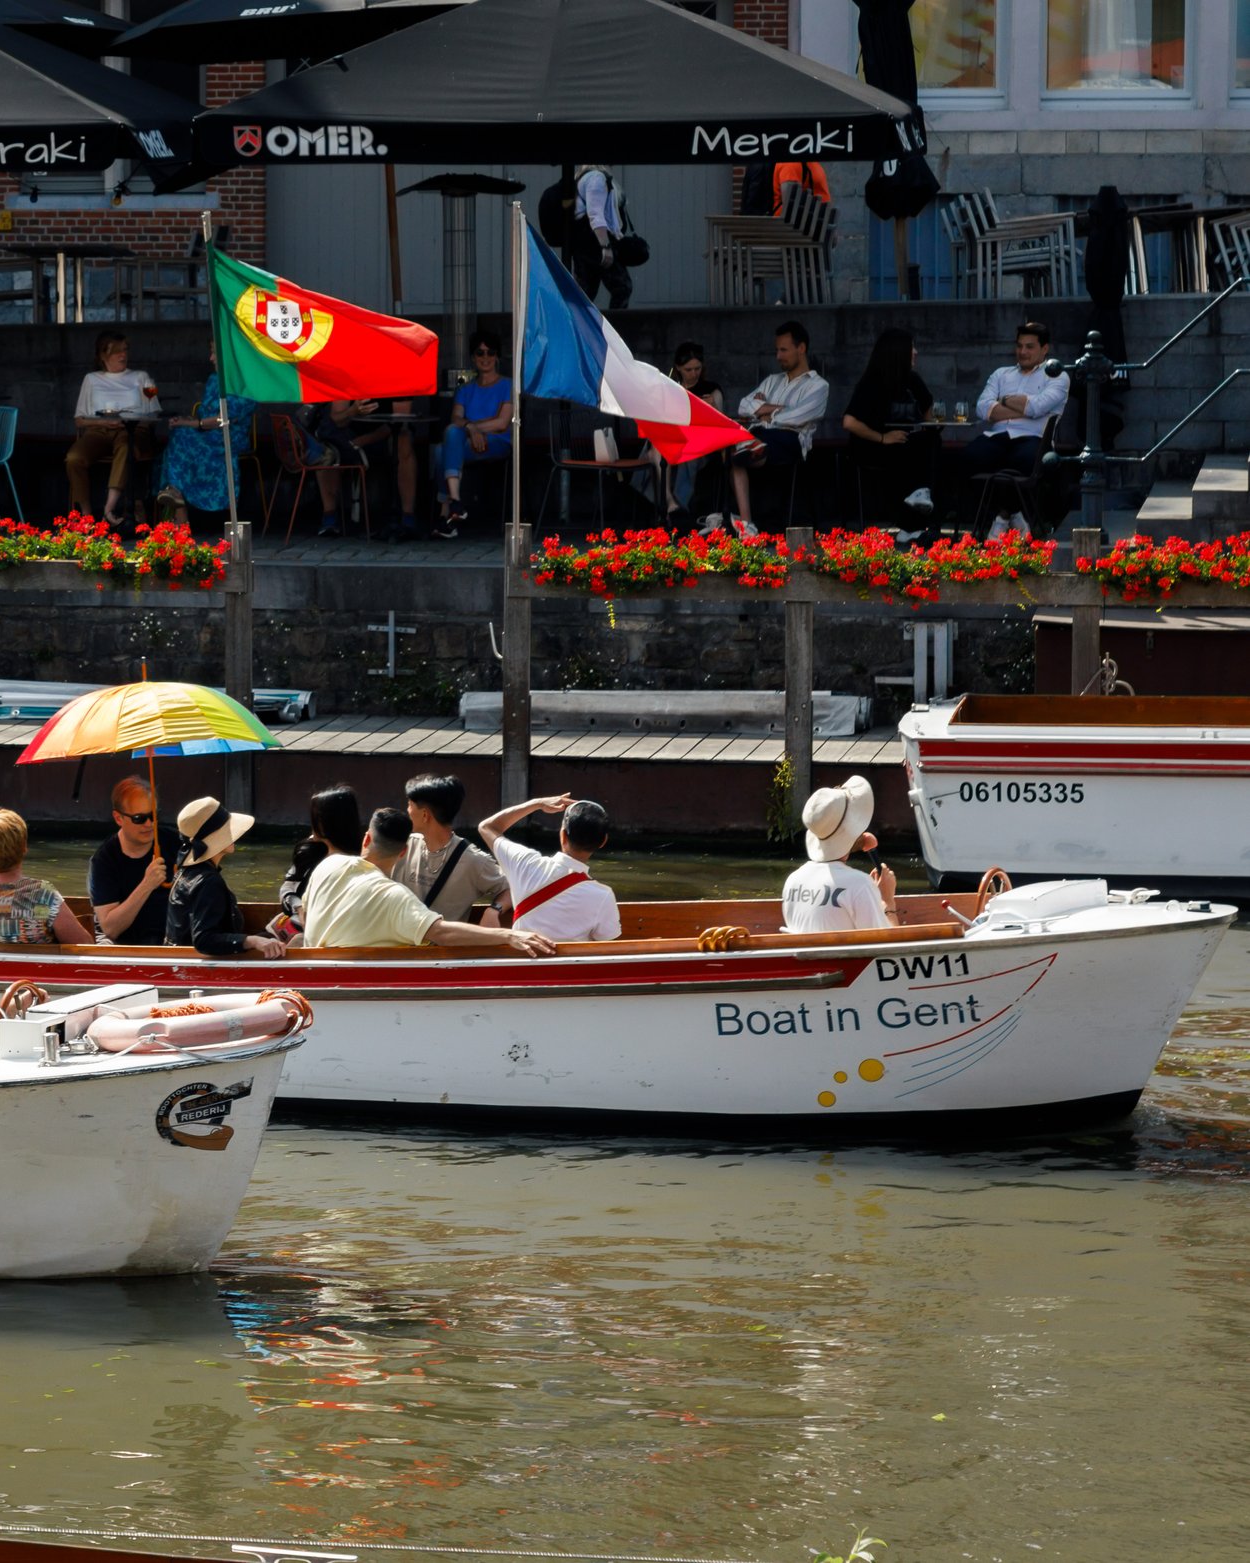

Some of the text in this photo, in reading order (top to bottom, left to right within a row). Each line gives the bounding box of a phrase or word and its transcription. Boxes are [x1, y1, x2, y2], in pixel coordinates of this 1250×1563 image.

[266, 125, 389, 157] OMER.
[692, 122, 853, 156] Meraki
[959, 781, 1085, 804] 06105335
[875, 952, 969, 982] DW11
[715, 994, 982, 1036] Boat in Gent
[180, 1104, 226, 1121] REDERIJ
